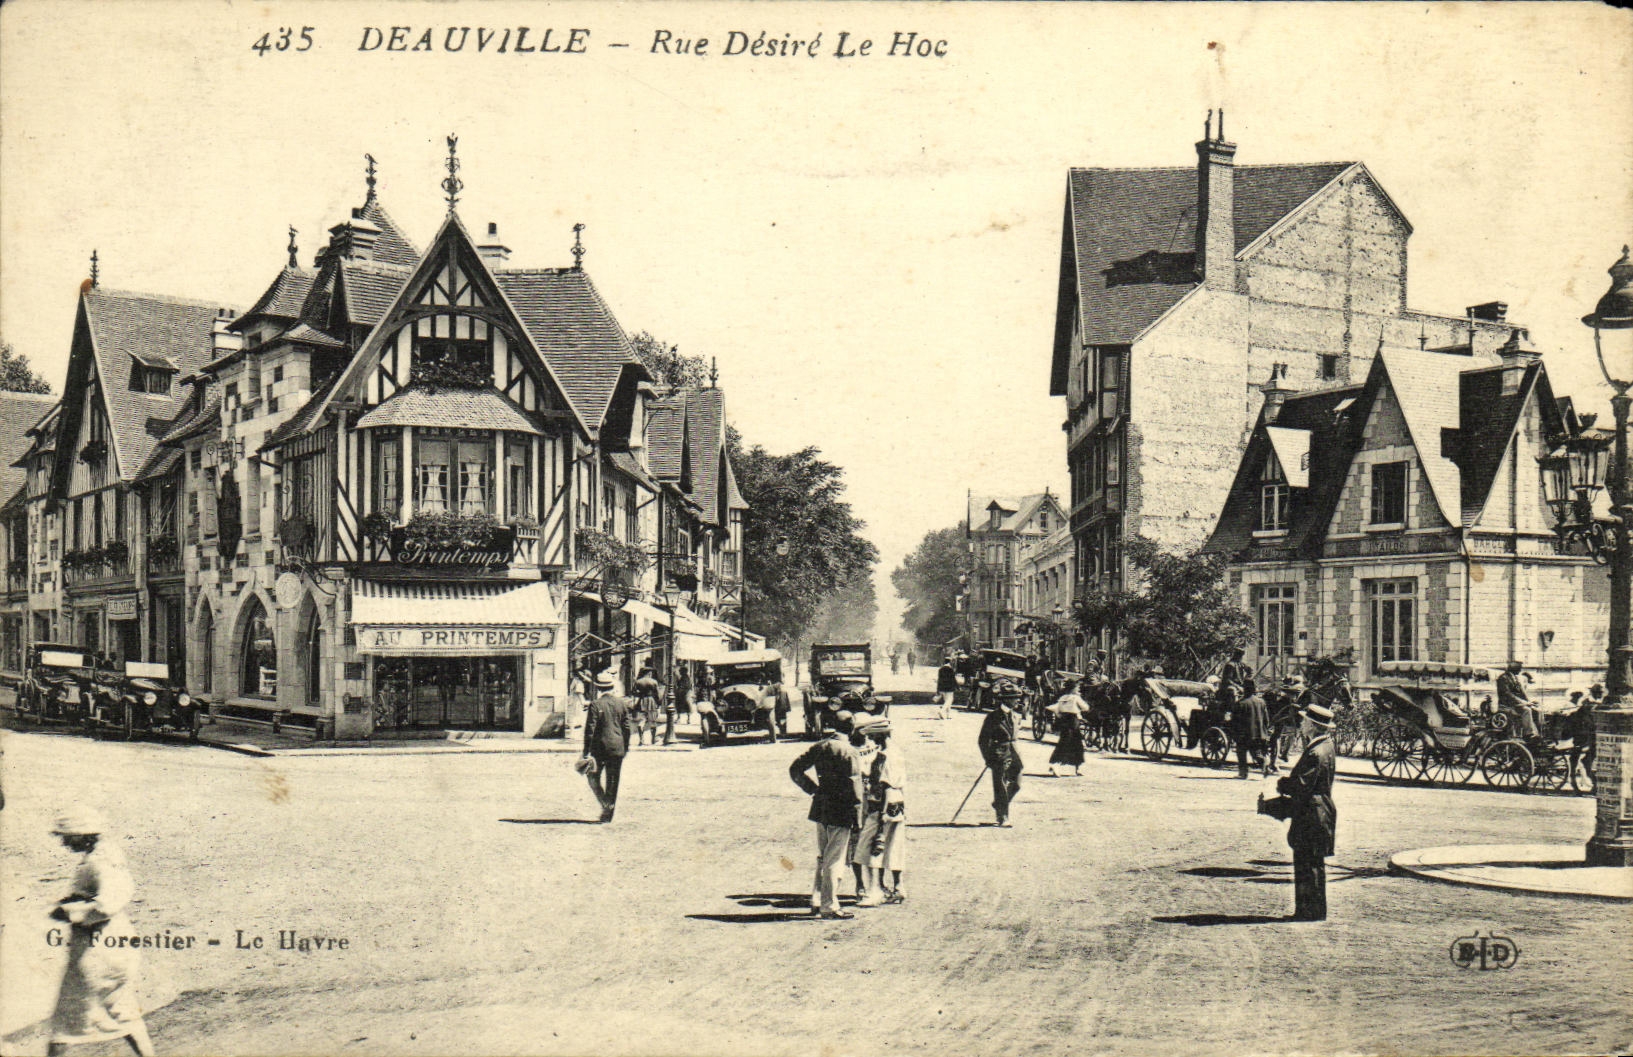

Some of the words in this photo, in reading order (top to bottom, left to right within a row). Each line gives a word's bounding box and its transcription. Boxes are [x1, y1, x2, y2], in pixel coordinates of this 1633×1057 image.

[398, 538, 510, 567] Printemps
[374, 631, 401, 646] AU
[421, 630, 542, 646] PRINTEMPS
